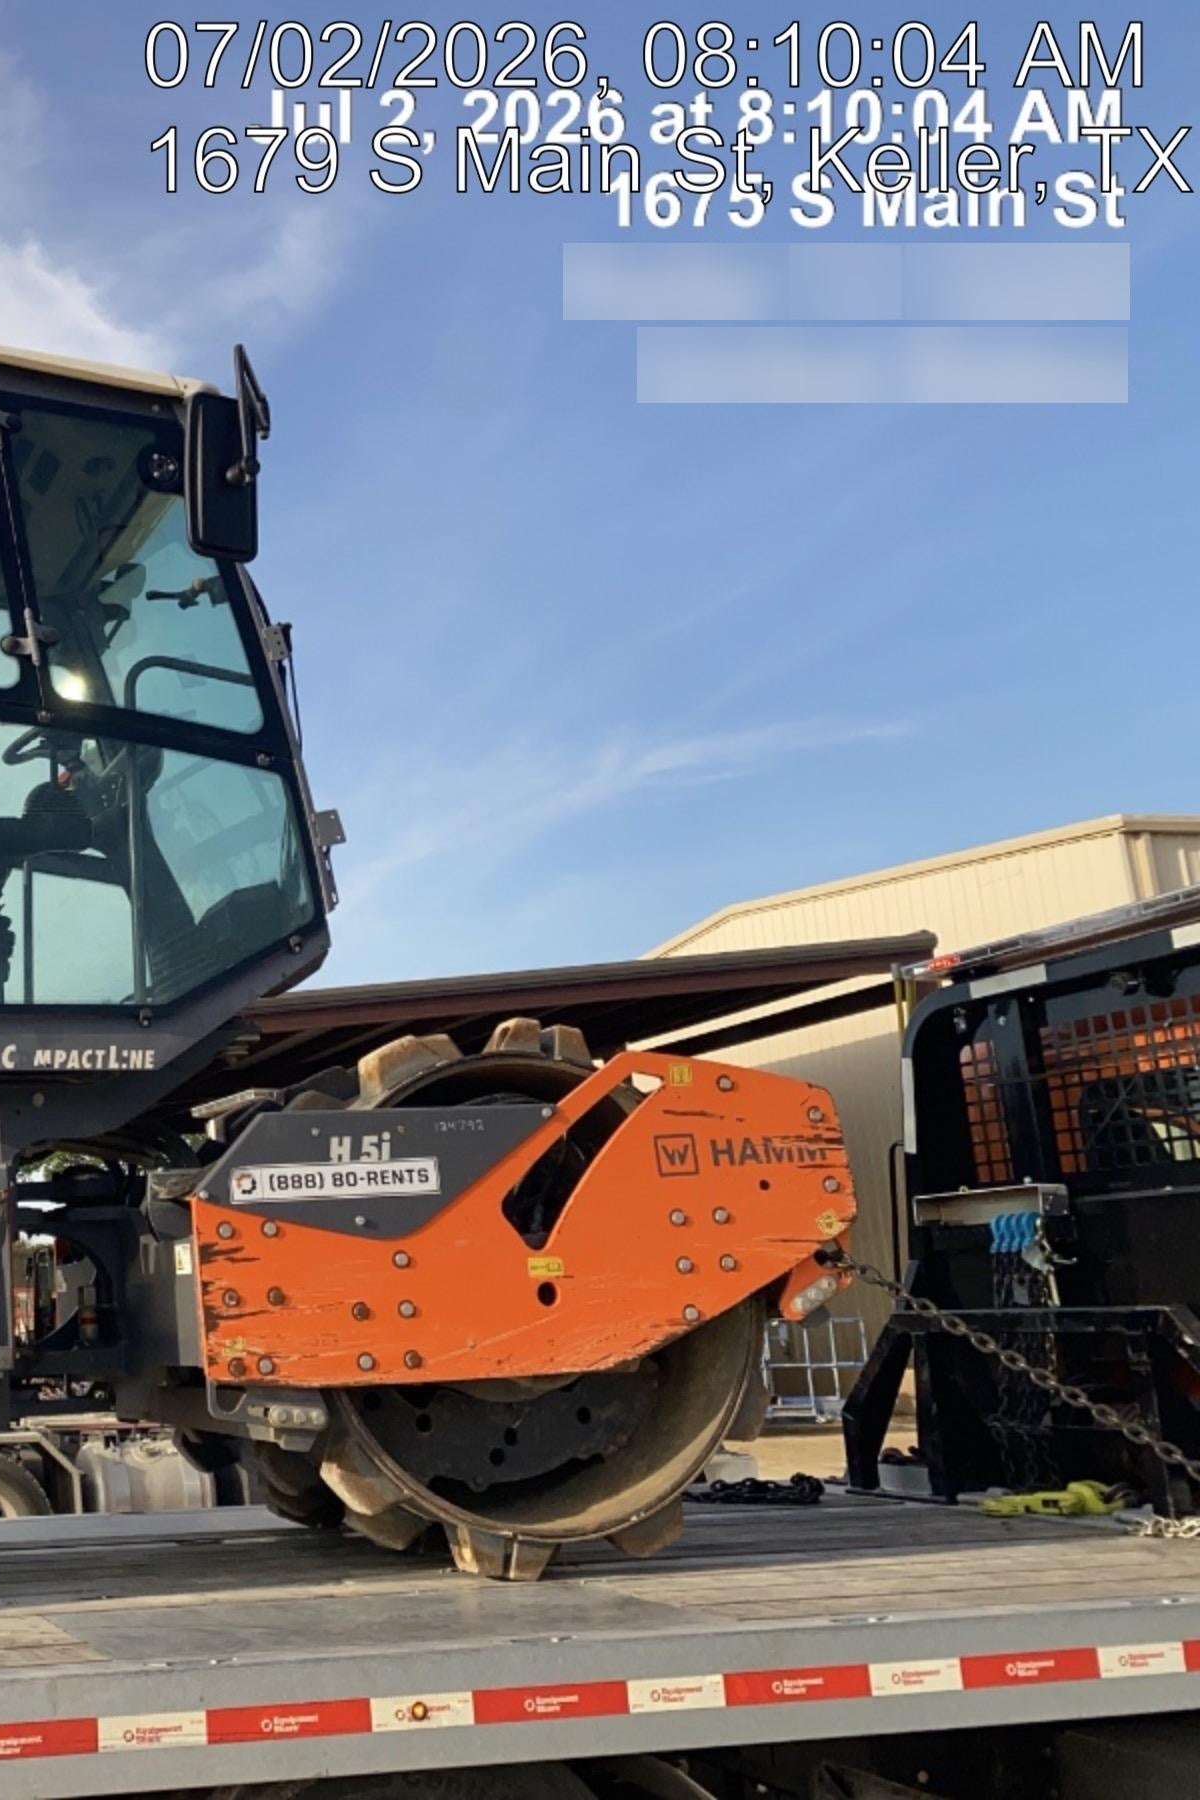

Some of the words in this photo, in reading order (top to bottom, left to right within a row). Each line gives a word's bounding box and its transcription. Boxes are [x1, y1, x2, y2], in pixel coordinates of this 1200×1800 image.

[710, 1134, 829, 1167] HAMM
[268, 1172, 325, 1192] (888)
[331, 1168, 430, 1188] 80-RENTS
